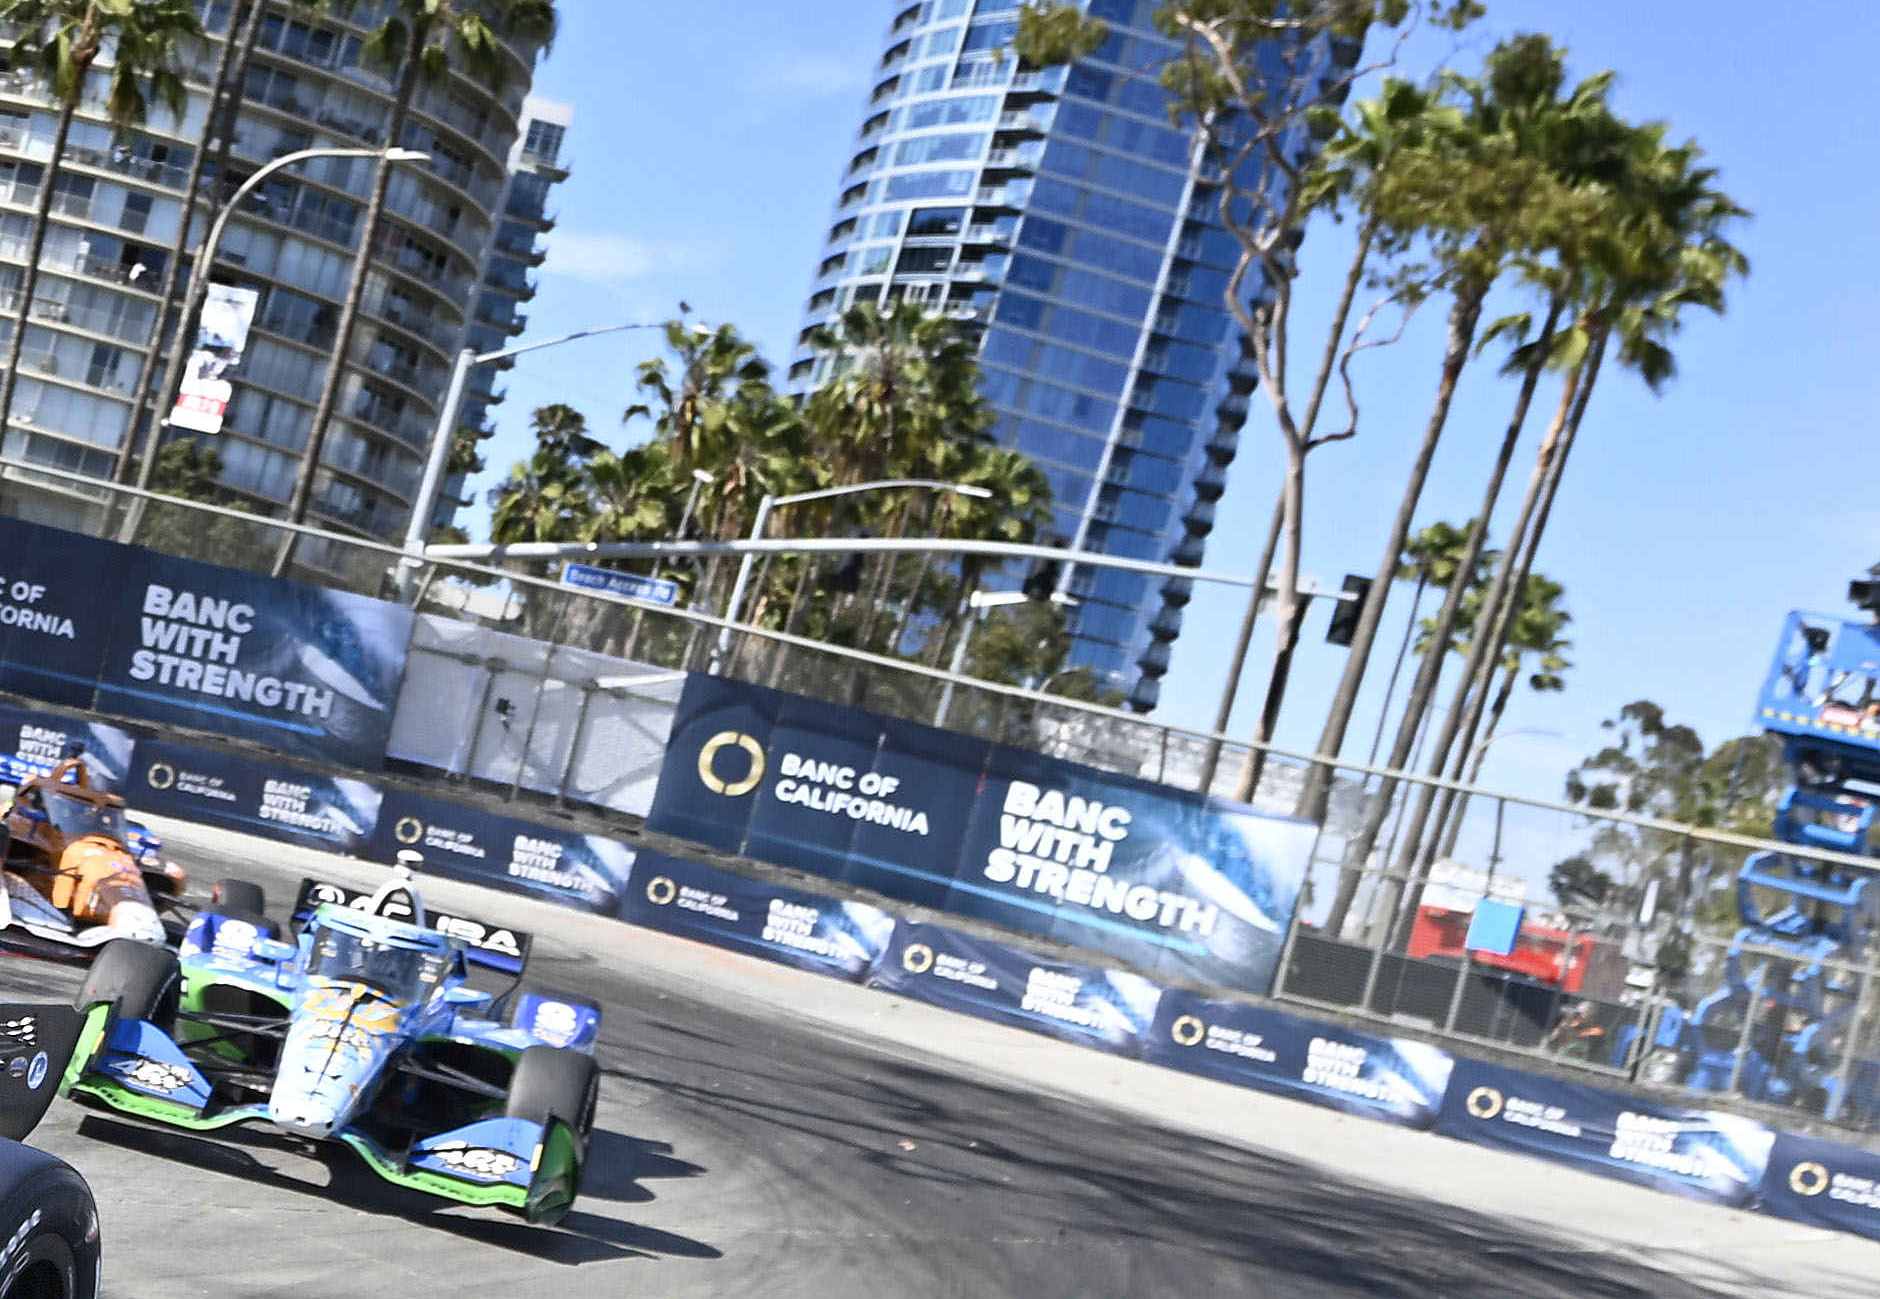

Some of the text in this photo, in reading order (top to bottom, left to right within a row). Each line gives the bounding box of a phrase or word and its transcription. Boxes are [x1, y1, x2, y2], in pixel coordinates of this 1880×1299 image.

[12, 579, 46, 604] OF
[143, 584, 255, 635] BANC
[141, 617, 241, 665] WITH
[130, 650, 334, 720] STRENGTH
[781, 753, 900, 796] BANC OF
[775, 779, 930, 837] CALIFORNIA
[1003, 781, 1132, 842] BANC
[998, 815, 1114, 873] WITH
[984, 847, 1220, 937] STRENGTH
